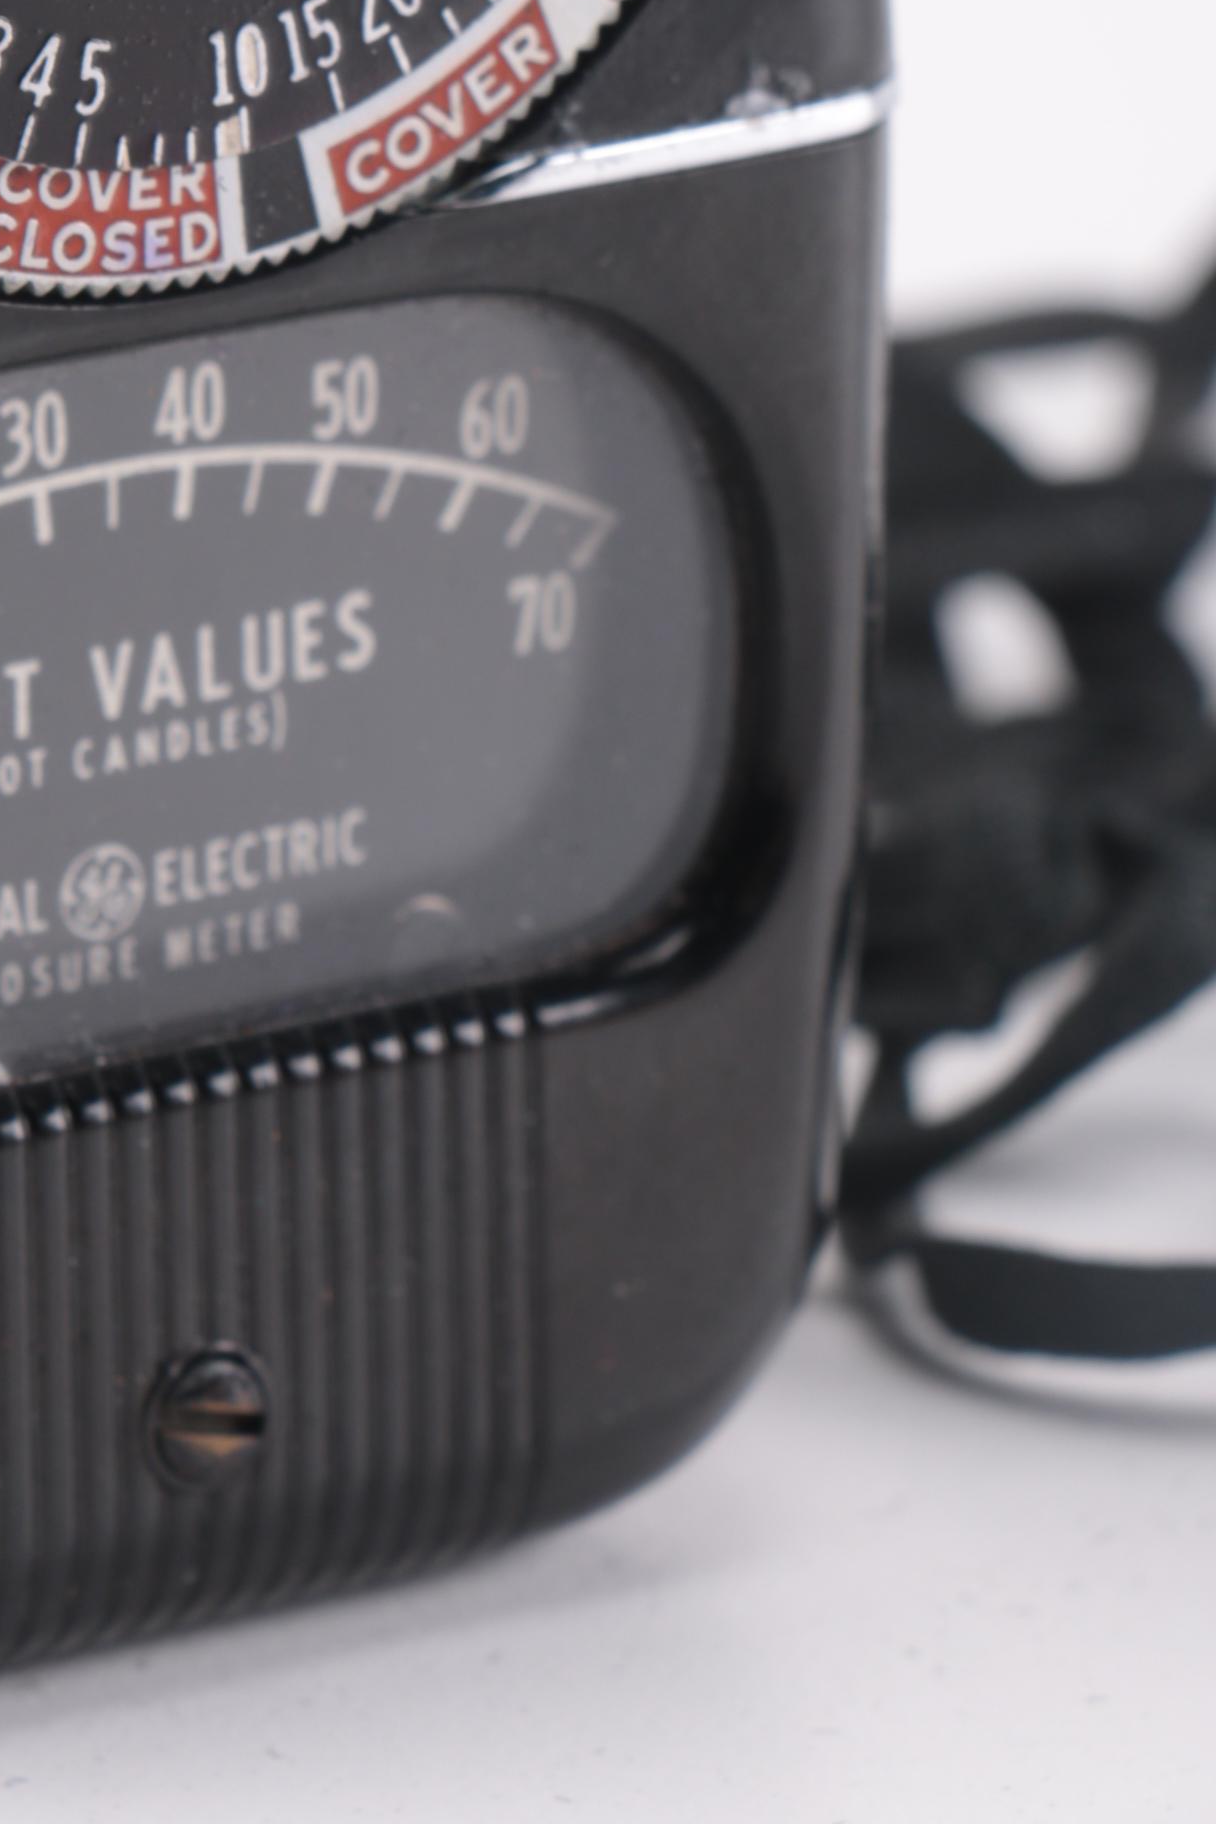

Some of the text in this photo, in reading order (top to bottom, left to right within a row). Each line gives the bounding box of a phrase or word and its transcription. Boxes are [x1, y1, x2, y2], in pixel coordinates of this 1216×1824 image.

[19, 33, 62, 107] 4
[75, 40, 112, 115] 5
[209, 23, 268, 107] 10
[345, 23, 552, 195] COVER
[154, 361, 226, 444] 40
[311, 355, 380, 441] 50
[459, 374, 528, 459] 60
[90, 589, 378, 722] VALUES
[508, 572, 576, 657] 70
[72, 689, 289, 779] CANDLES)
[153, 807, 367, 908] ELECTRIC
[165, 901, 302, 969] METER
